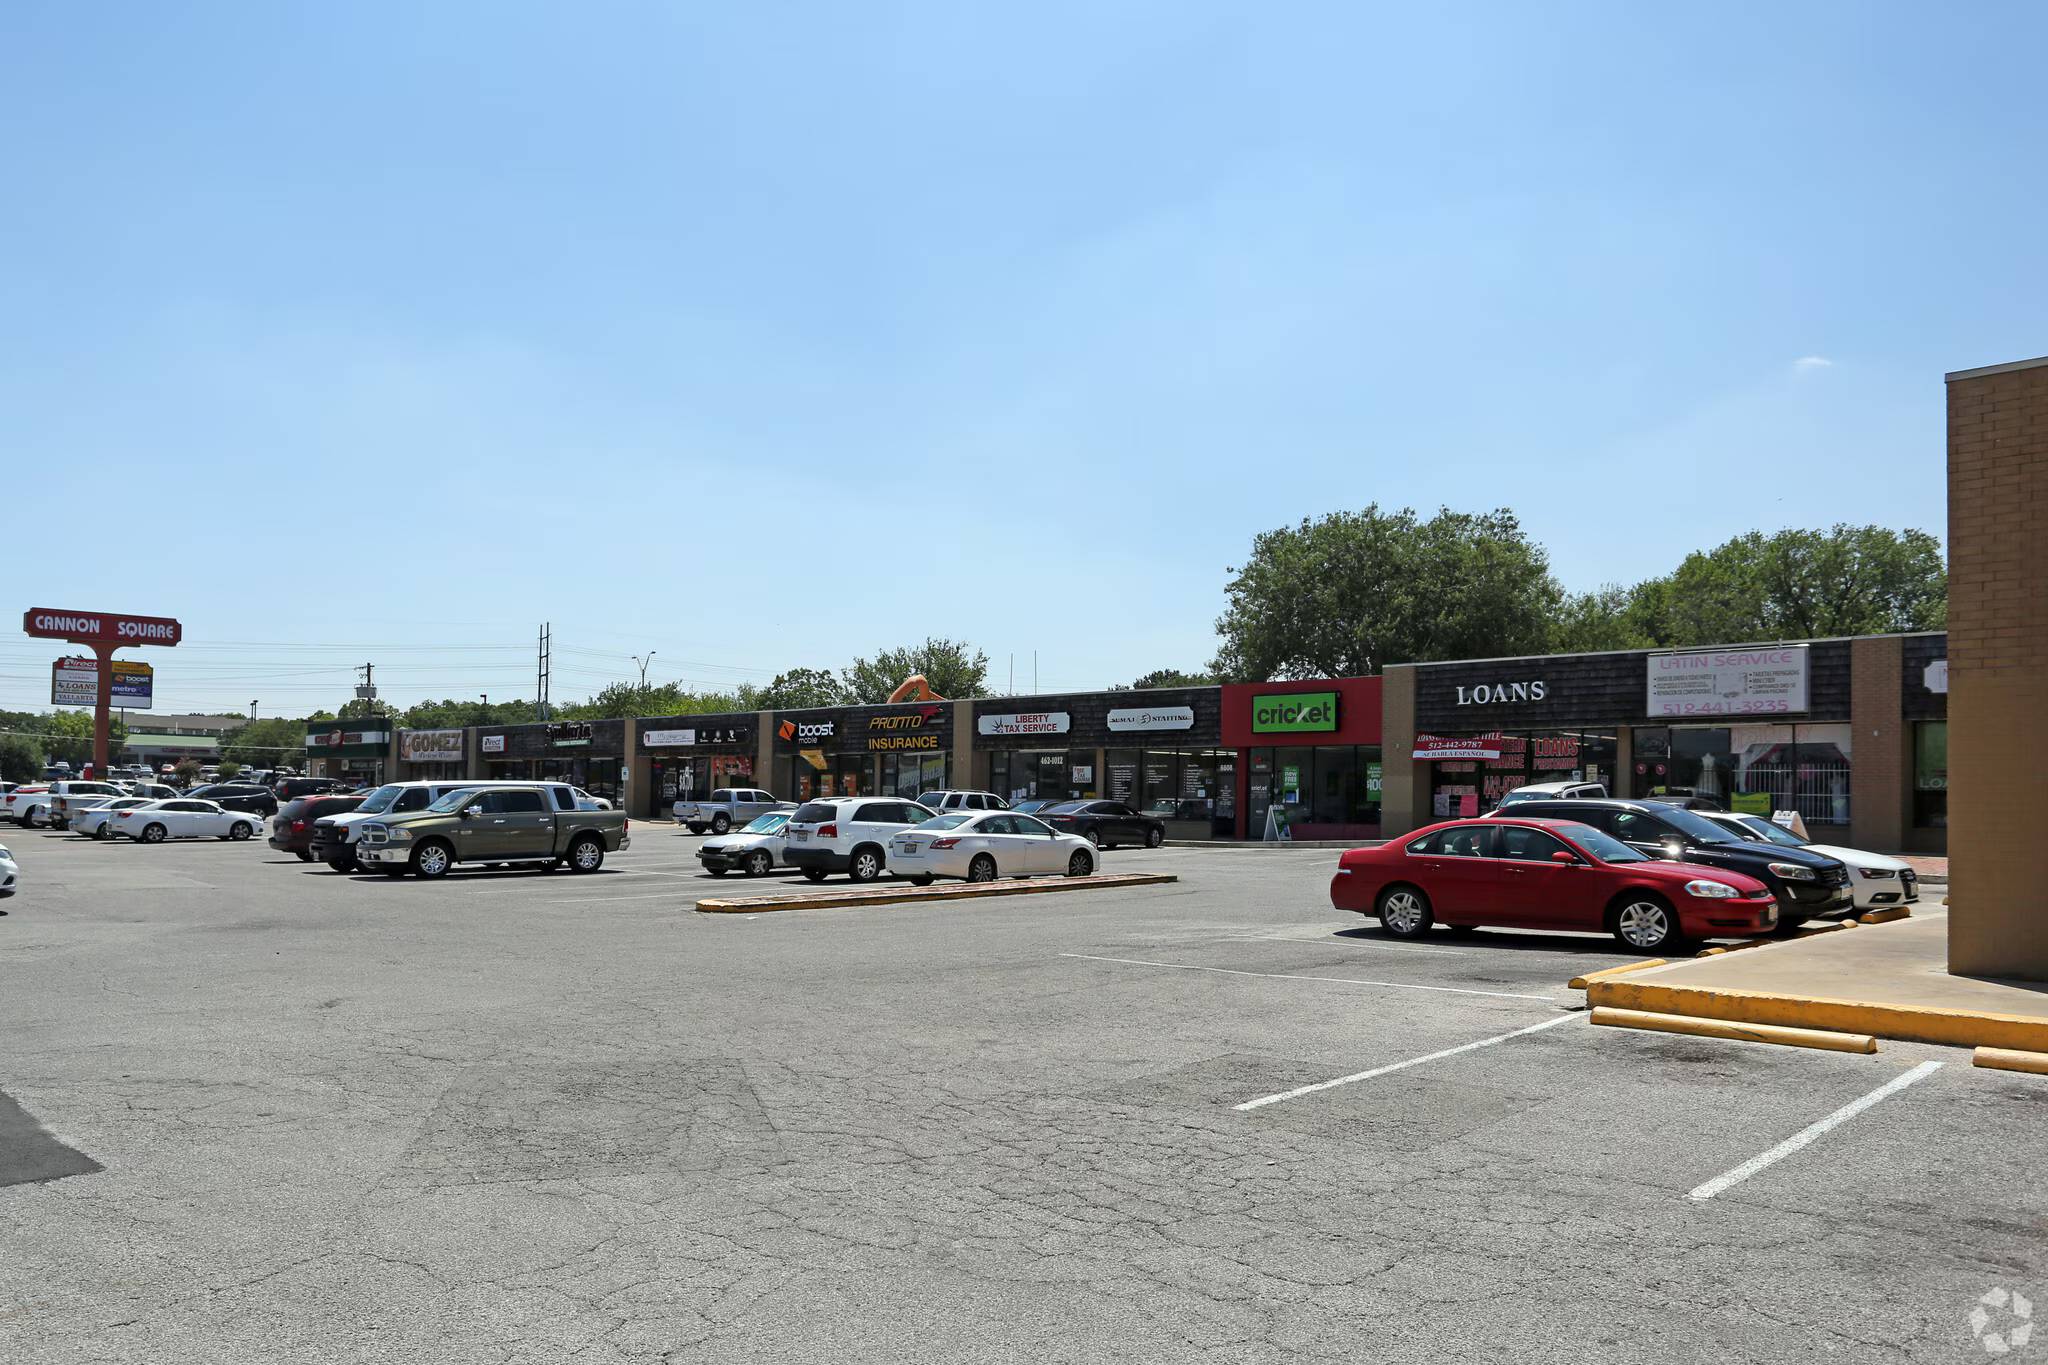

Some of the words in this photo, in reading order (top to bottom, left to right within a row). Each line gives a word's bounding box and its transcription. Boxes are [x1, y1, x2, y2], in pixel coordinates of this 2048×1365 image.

[35, 615, 100, 634] CANNON
[118, 621, 174, 639] SQUARE
[1660, 656, 1708, 670] LATIN
[1714, 651, 1793, 667] SERVICE
[66, 682, 97, 690] LOANS
[126, 675, 150, 683] boost
[1456, 680, 1545, 705] LOANS
[1015, 714, 1050, 724] LIBERTY
[1257, 701, 1332, 725] cricket
[798, 720, 835, 737] boost
[869, 715, 923, 730] PRONTO
[1004, 724, 1021, 733] TAX
[1022, 723, 1057, 733] SERVICE
[411, 732, 461, 752] GOMEZ
[868, 735, 938, 750] INSURANCE
[1428, 741, 1483, 750] 512-442-9787
[1534, 737, 1579, 757] LOANS
